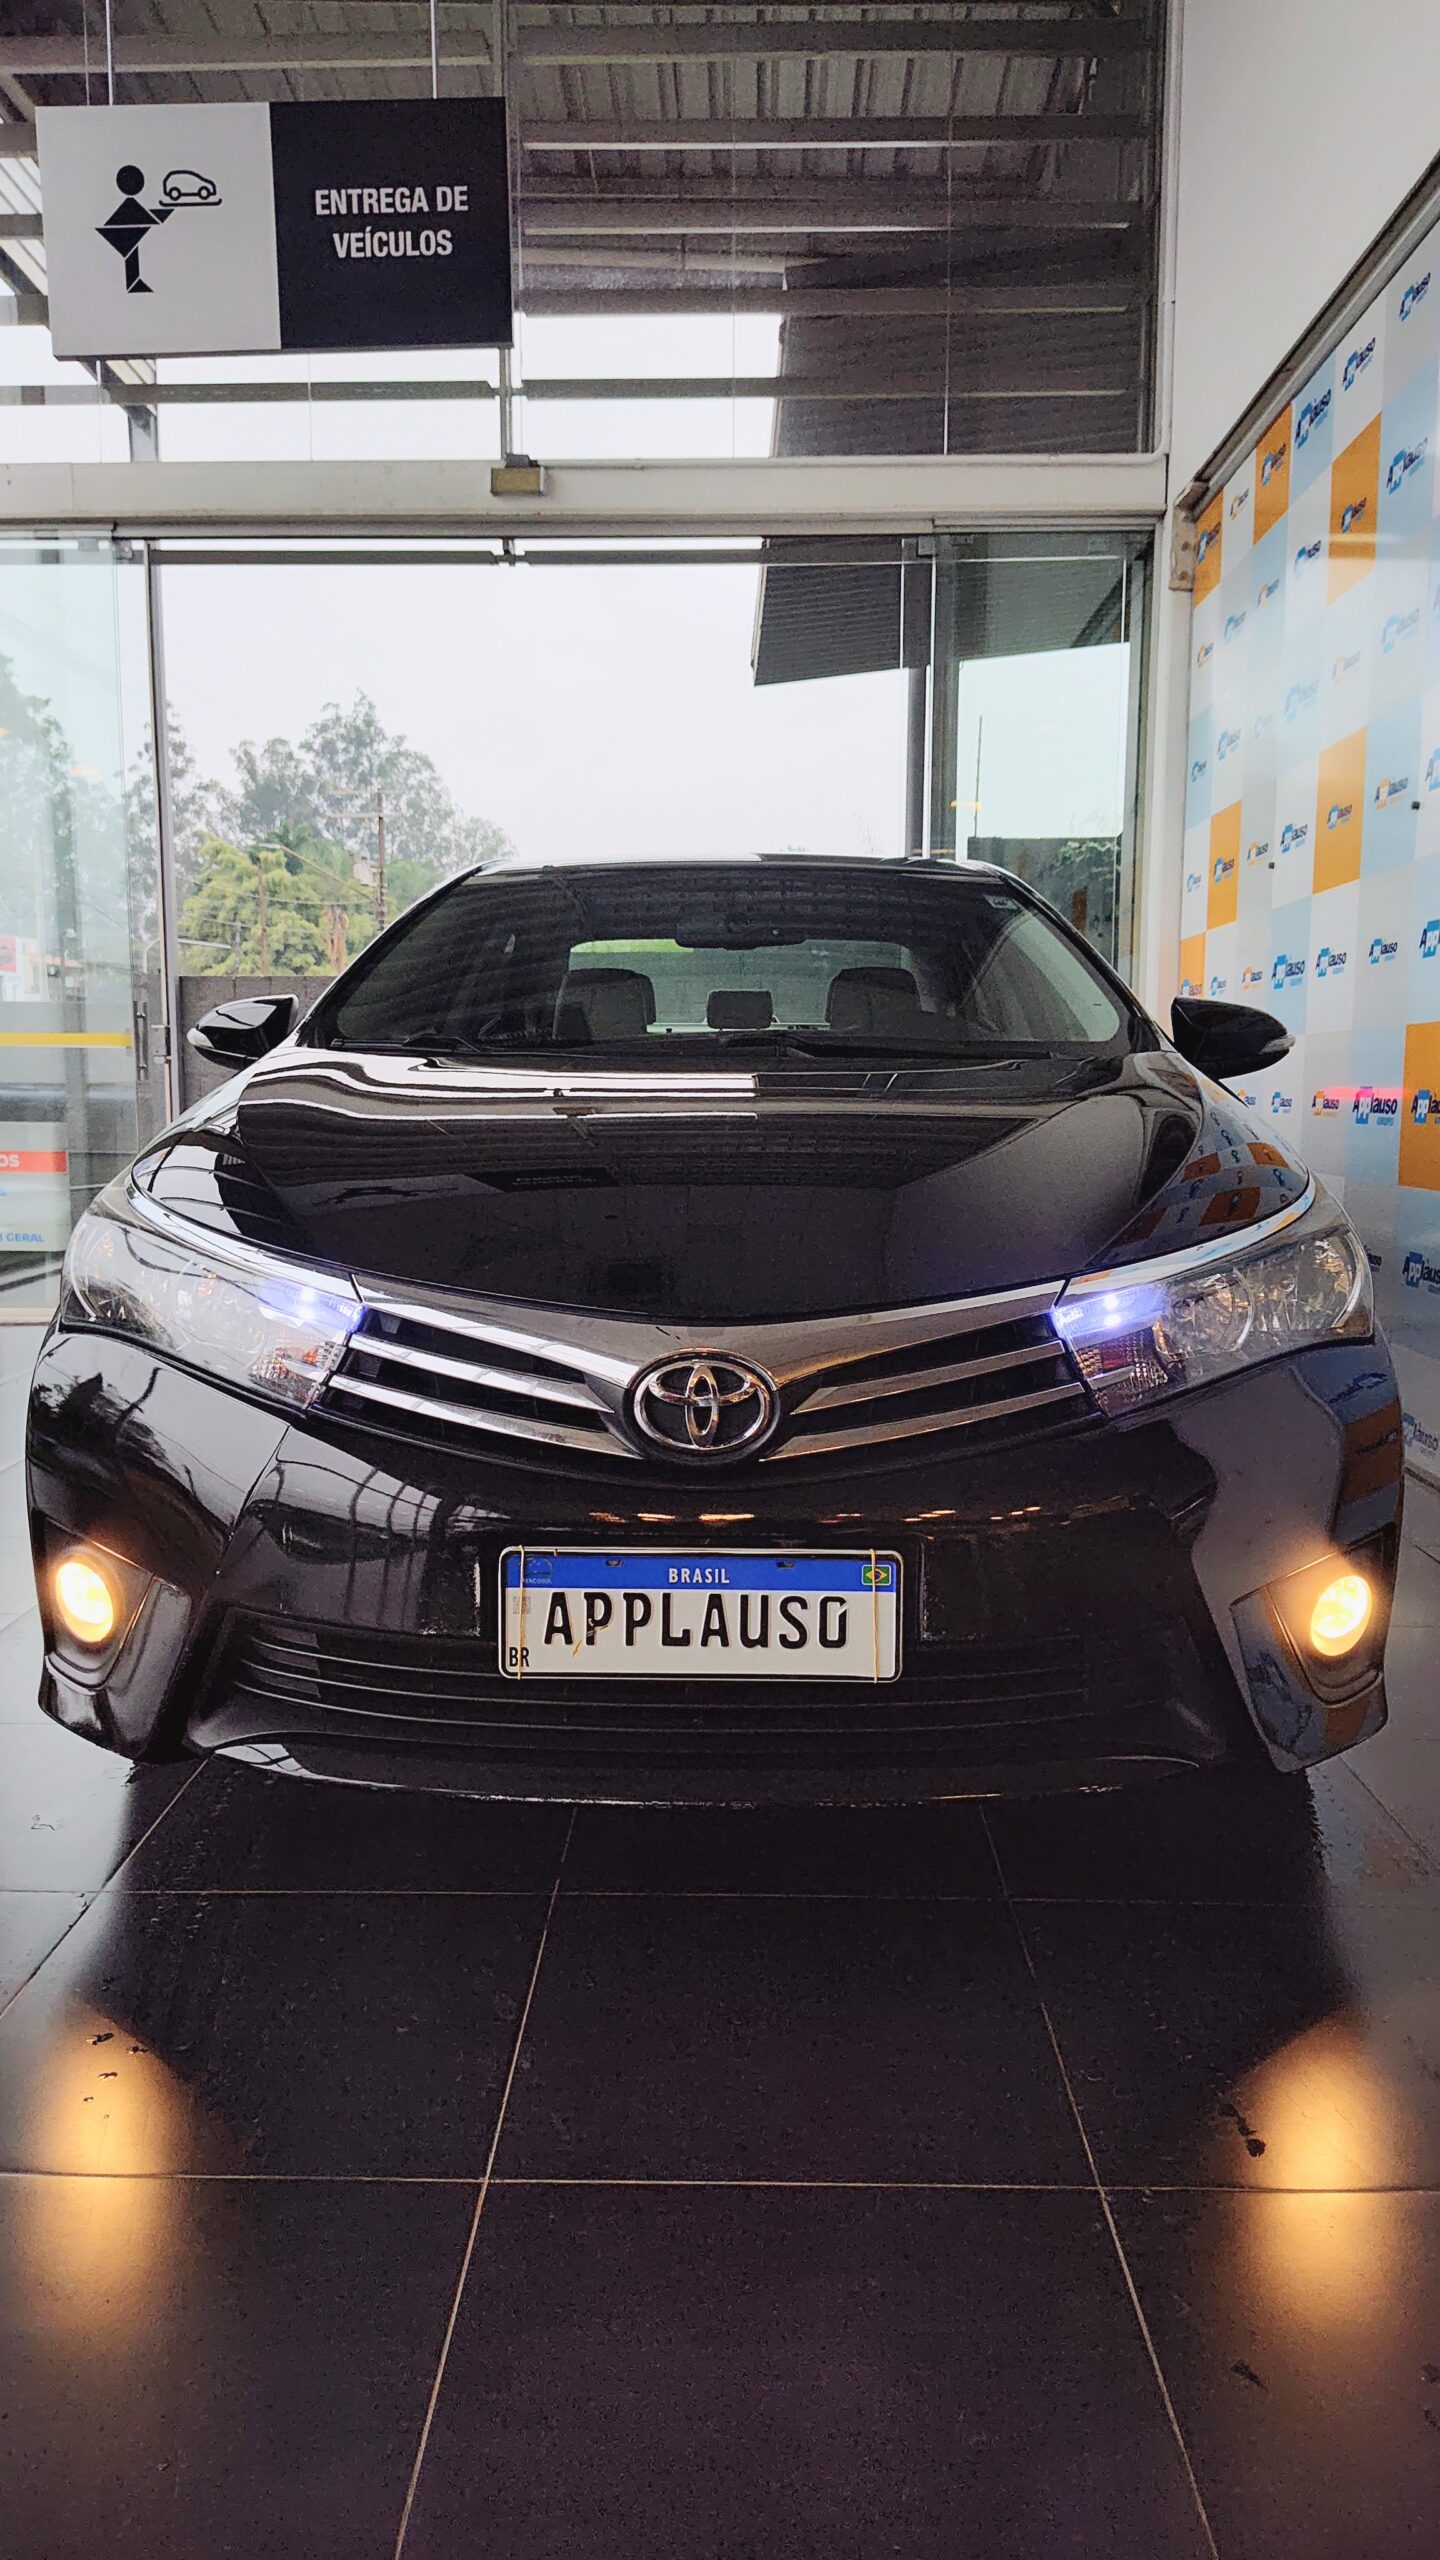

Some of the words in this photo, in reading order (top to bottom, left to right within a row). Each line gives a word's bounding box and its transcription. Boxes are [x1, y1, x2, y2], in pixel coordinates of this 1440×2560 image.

[315, 187, 430, 216] ENTREGA
[436, 186, 469, 212] DE
[333, 226, 453, 258] VEÍCULOS
[668, 1568, 730, 1584] BRASIL
[544, 1591, 848, 1649] APPLAUSO
[508, 1646, 530, 1668] BR
